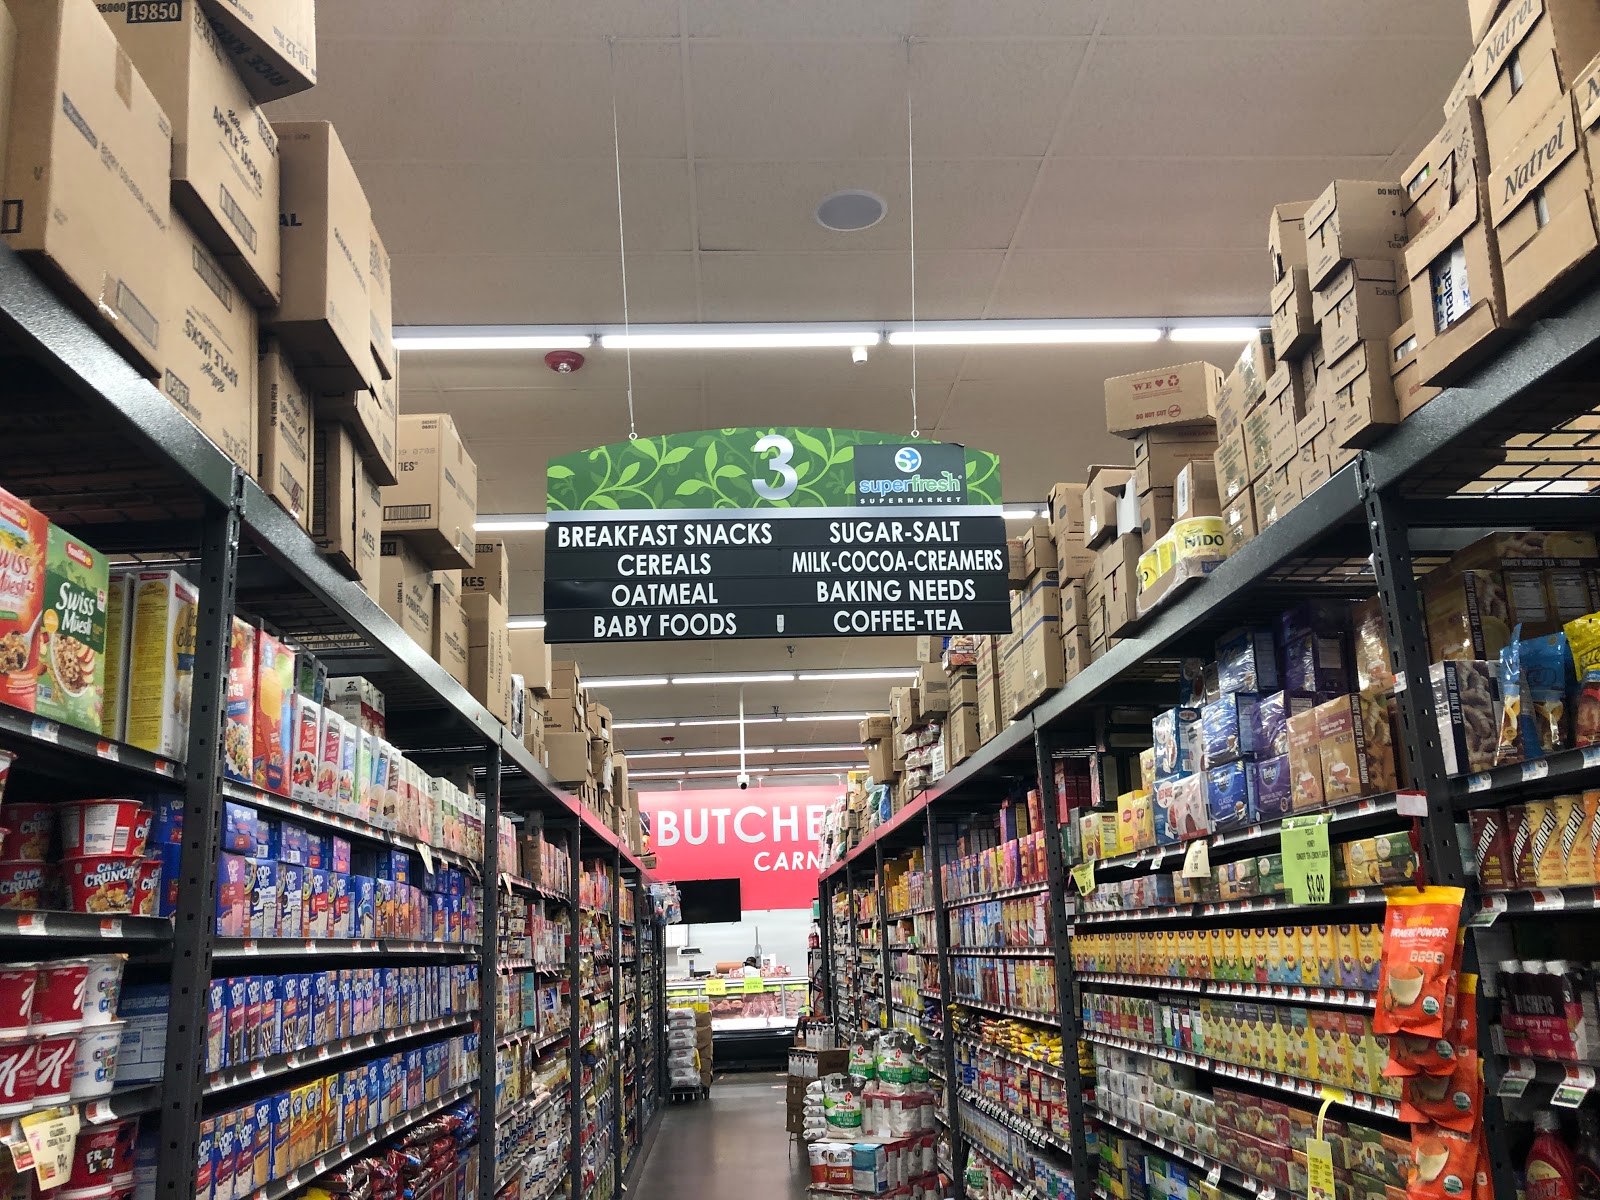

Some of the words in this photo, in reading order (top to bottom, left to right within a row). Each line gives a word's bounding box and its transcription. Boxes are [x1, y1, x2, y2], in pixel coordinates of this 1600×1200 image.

[129, 2, 179, 21] 19850
[1503, 115, 1566, 206] Natrel
[1377, 188, 1387, 196] DO
[1387, 188, 1401, 196] NOT
[1375, 287, 1397, 296] East
[1132, 381, 1152, 391] WE
[751, 434, 798, 500] 3
[859, 470, 961, 498] superfresh
[859, 496, 962, 505] SUPERMARKET
[557, 523, 680, 548] BREAKFAST
[683, 522, 773, 546] SNACKS
[829, 520, 961, 544] SUGAR-SALT
[1184, 534, 1225, 547] NIDO
[0, 546, 30, 575] wiss
[617, 552, 712, 577] CEREALS
[791, 549, 1004, 574] MILK-COCOA-CREAMERS
[56, 582, 95, 616] Swiss
[611, 582, 719, 607] OATMEAL
[816, 579, 901, 603] BAKING
[908, 578, 976, 602] NEEDS
[593, 614, 654, 638] BABY
[658, 612, 737, 636] FOODS
[833, 609, 964, 634] COFFEE-TEA
[1446, 666, 1456, 691] GINGER
[1450, 692, 1460, 711] MILK
[1452, 711, 1462, 725] TEA
[1357, 736, 1365, 748] TEA
[657, 804, 826, 847] BUTCHE
[84, 866, 135, 888] CRUNCH
[1416, 927, 1449, 939] POWDER
